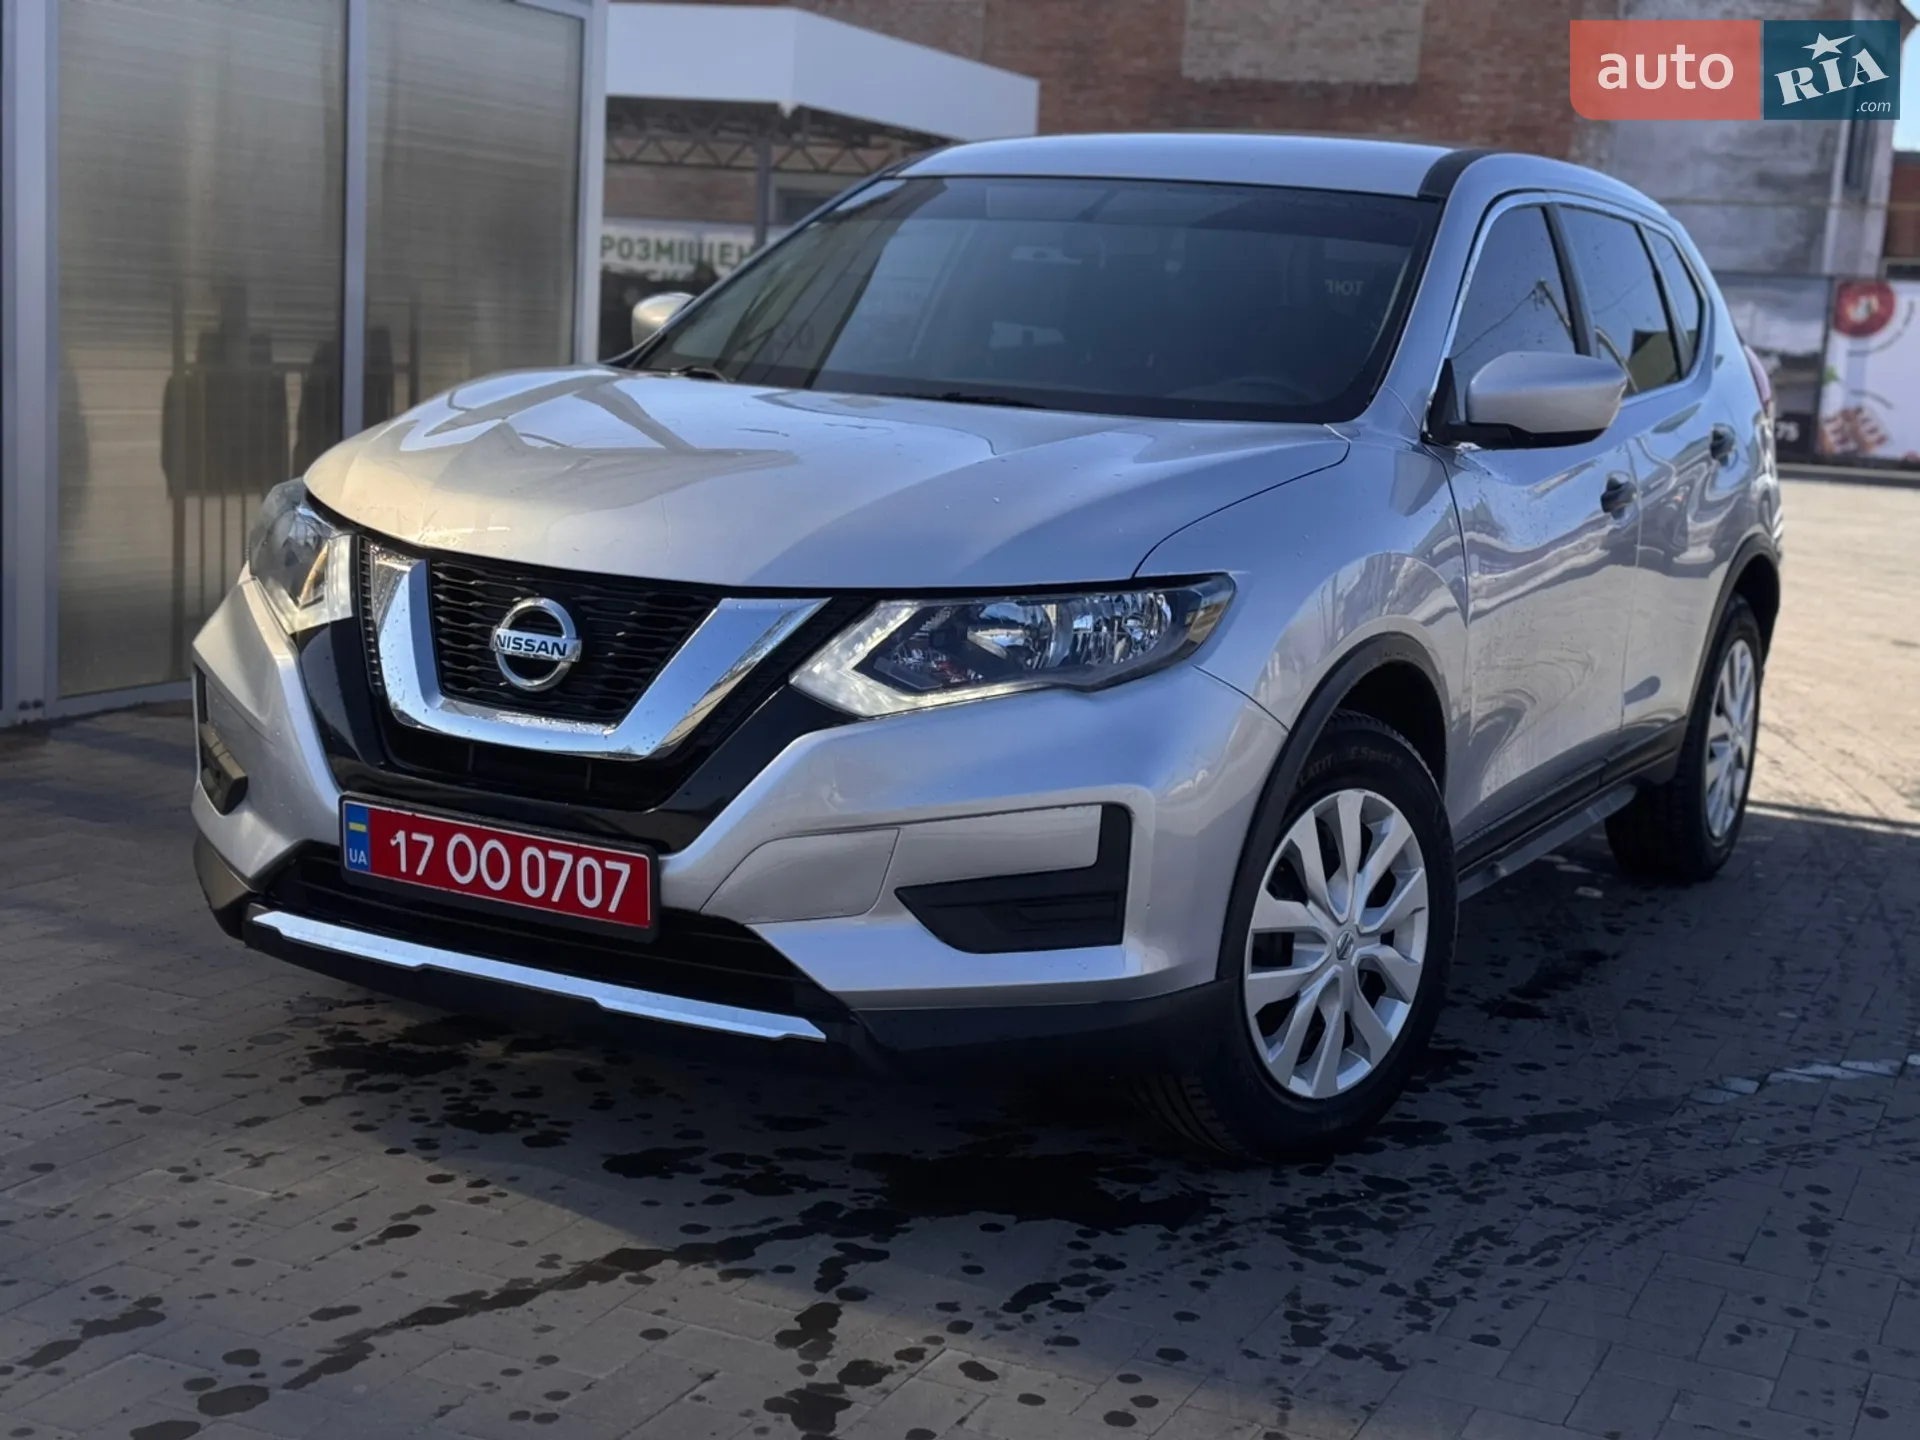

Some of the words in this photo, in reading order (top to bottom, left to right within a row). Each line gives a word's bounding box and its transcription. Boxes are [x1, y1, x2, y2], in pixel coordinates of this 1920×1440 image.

[496, 633, 568, 657] NISSAN
[349, 848, 368, 866] UA
[390, 829, 436, 876] 17
[520, 846, 632, 913] 0707
